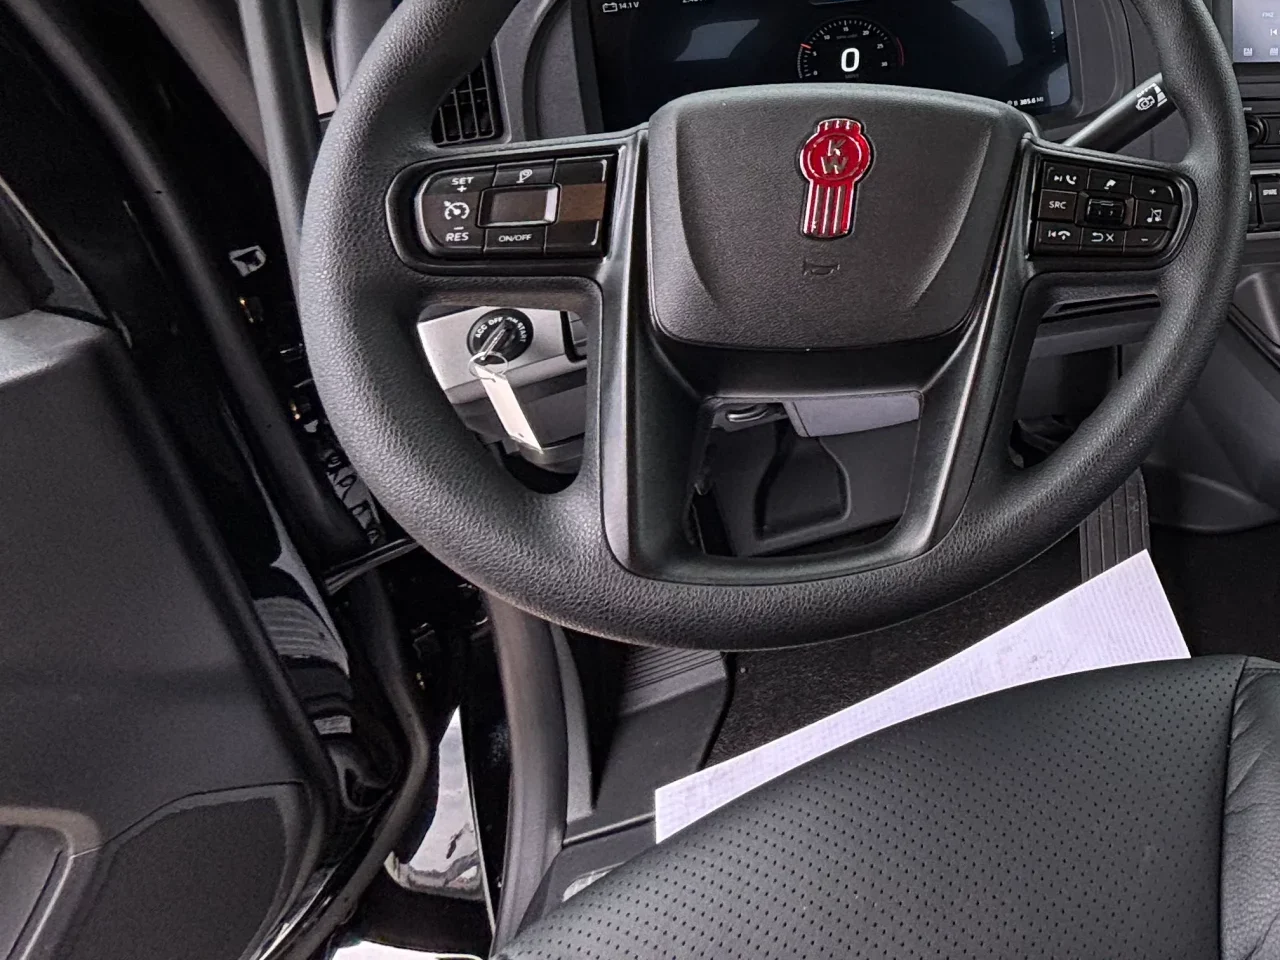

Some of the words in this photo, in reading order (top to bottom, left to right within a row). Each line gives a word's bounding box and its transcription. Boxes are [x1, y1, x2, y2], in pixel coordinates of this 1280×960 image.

[618, 2, 633, 10] 14.1
[841, 47, 860, 72] 0
[451, 176, 474, 186] SET
[1049, 201, 1067, 210] SRC
[445, 232, 469, 242] RES
[498, 234, 532, 243] ON/OFF
[475, 324, 488, 338] ACC
[488, 317, 503, 326] OFF
[516, 322, 527, 343] START
